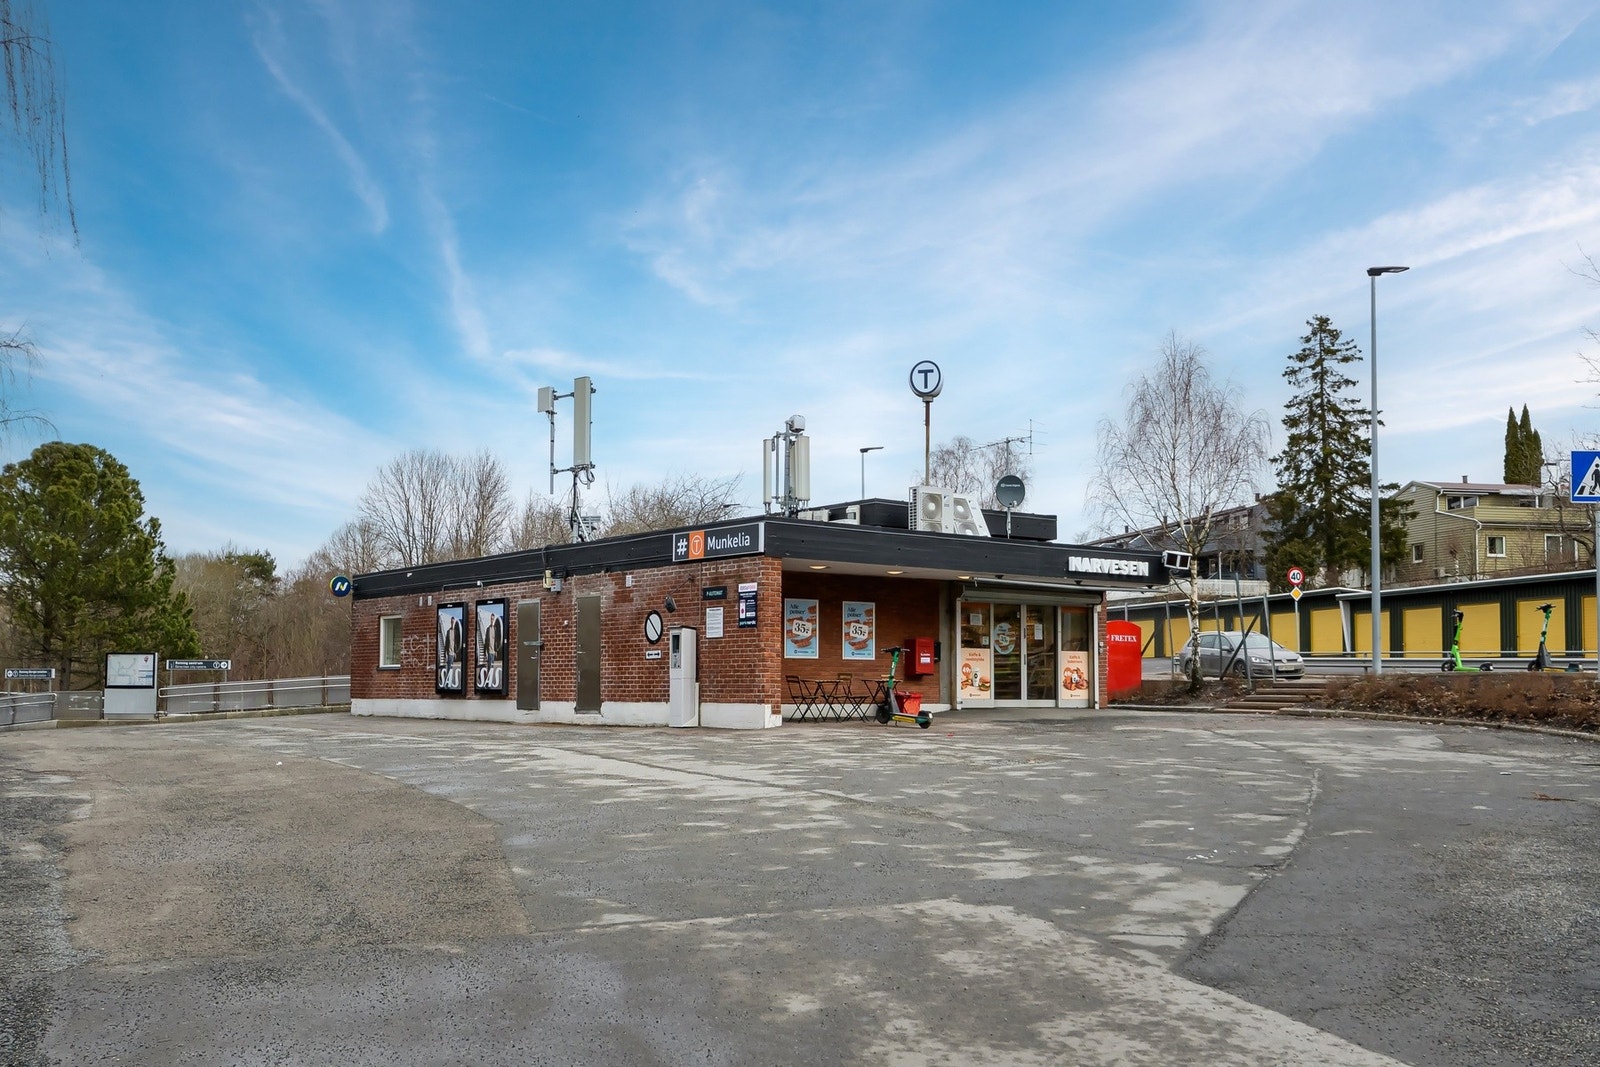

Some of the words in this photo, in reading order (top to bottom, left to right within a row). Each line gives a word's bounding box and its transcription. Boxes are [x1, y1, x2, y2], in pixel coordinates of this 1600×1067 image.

[917, 369, 934, 389] T
[707, 532, 750, 551] Munkelia
[1068, 556, 1149, 577] NARVESEN
[1291, 572, 1301, 581] 40
[1110, 634, 1137, 643] FRETEX
[438, 668, 461, 688] SAS
[476, 667, 503, 688] SAS
